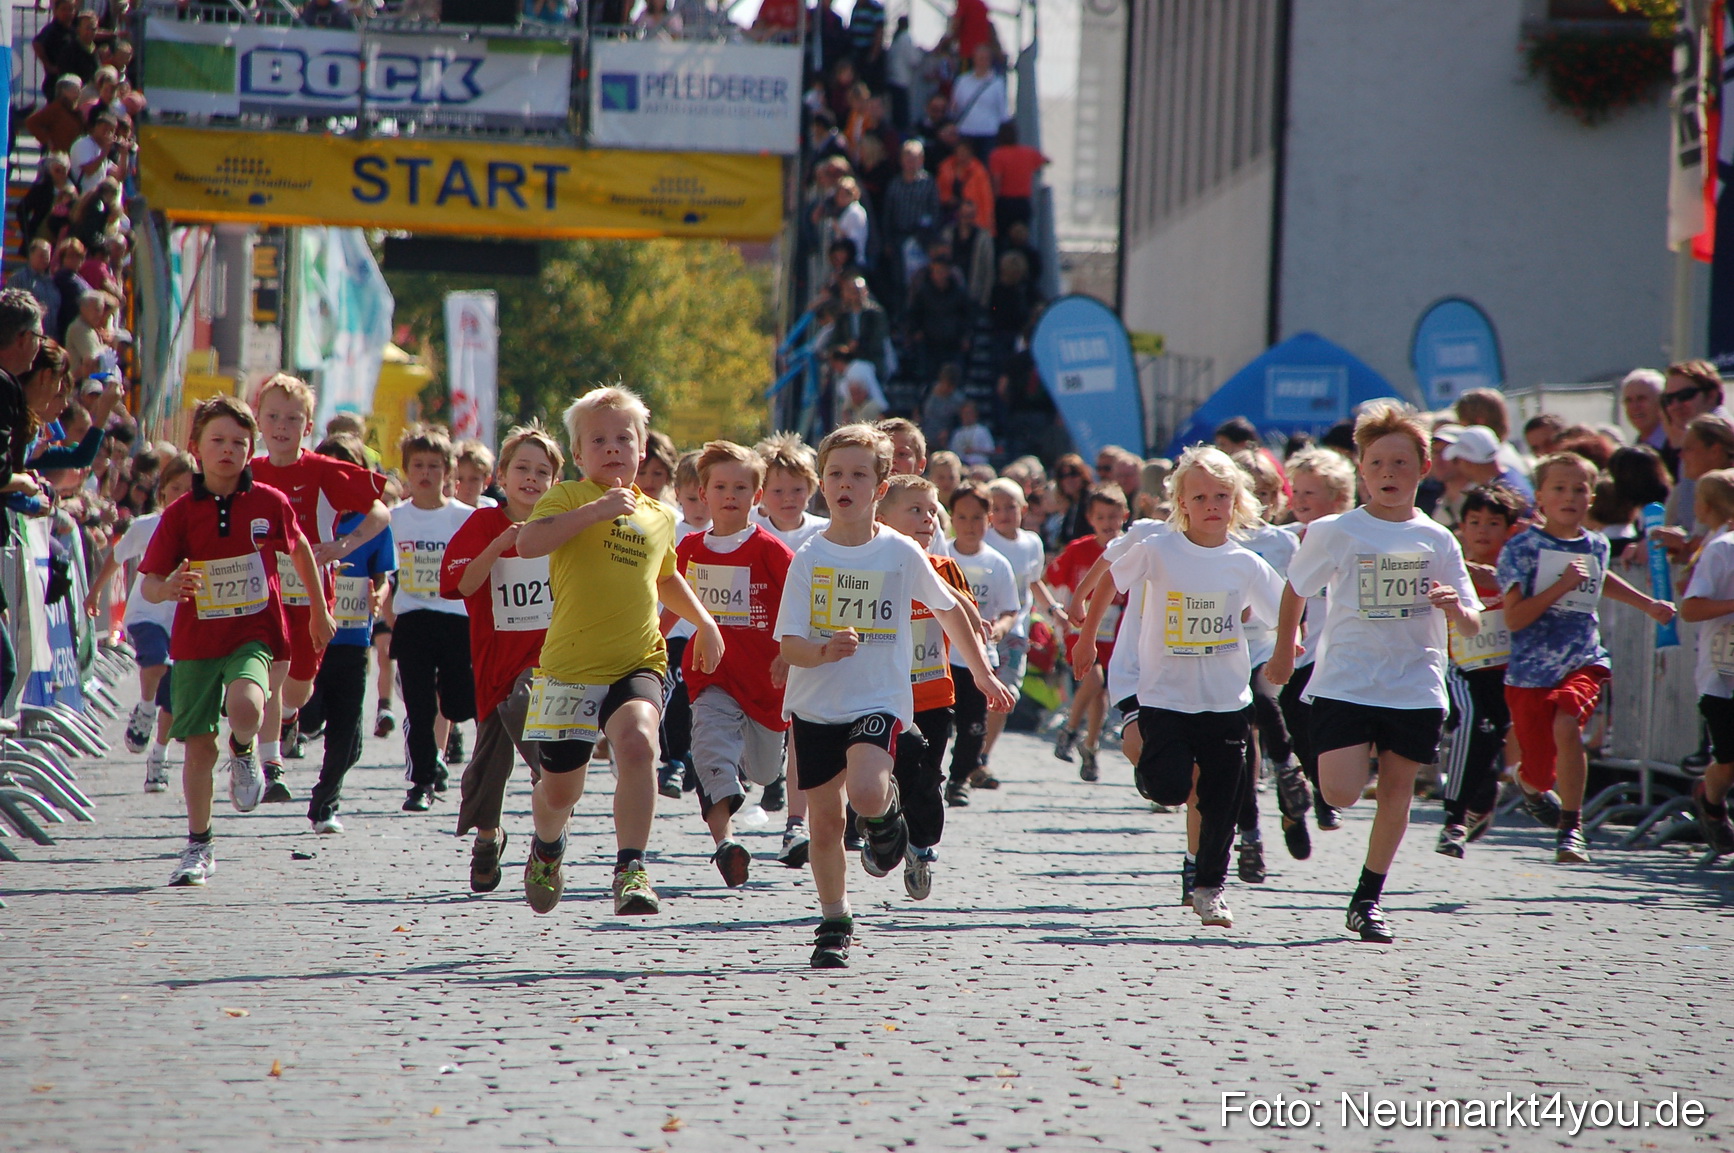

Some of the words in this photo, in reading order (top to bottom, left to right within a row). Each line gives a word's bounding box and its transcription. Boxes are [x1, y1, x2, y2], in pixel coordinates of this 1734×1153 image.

[241, 46, 485, 104] BOCK
[646, 72, 789, 103] PFLEIDERER
[352, 155, 570, 211] START
[610, 529, 645, 545] skinfit
[603, 540, 612, 548] TV
[614, 542, 648, 559] Hilpoltstein
[209, 561, 254, 576] Jonathan
[611, 553, 638, 567] Triathlon
[1381, 556, 1430, 571] Alexander
[697, 568, 709, 580] Uli
[837, 574, 869, 590] Kilian
[213, 576, 261, 598] 7278
[497, 577, 554, 607] 1021
[699, 586, 743, 606] 7094
[1382, 577, 1430, 597] 7015
[814, 593, 826, 605] K4
[837, 597, 893, 620] 7116
[1185, 597, 1215, 609] Tizian
[1187, 614, 1234, 635] 7084
[1465, 630, 1507, 651] 7005
[914, 642, 939, 661] 04
[544, 695, 597, 717] 7273
